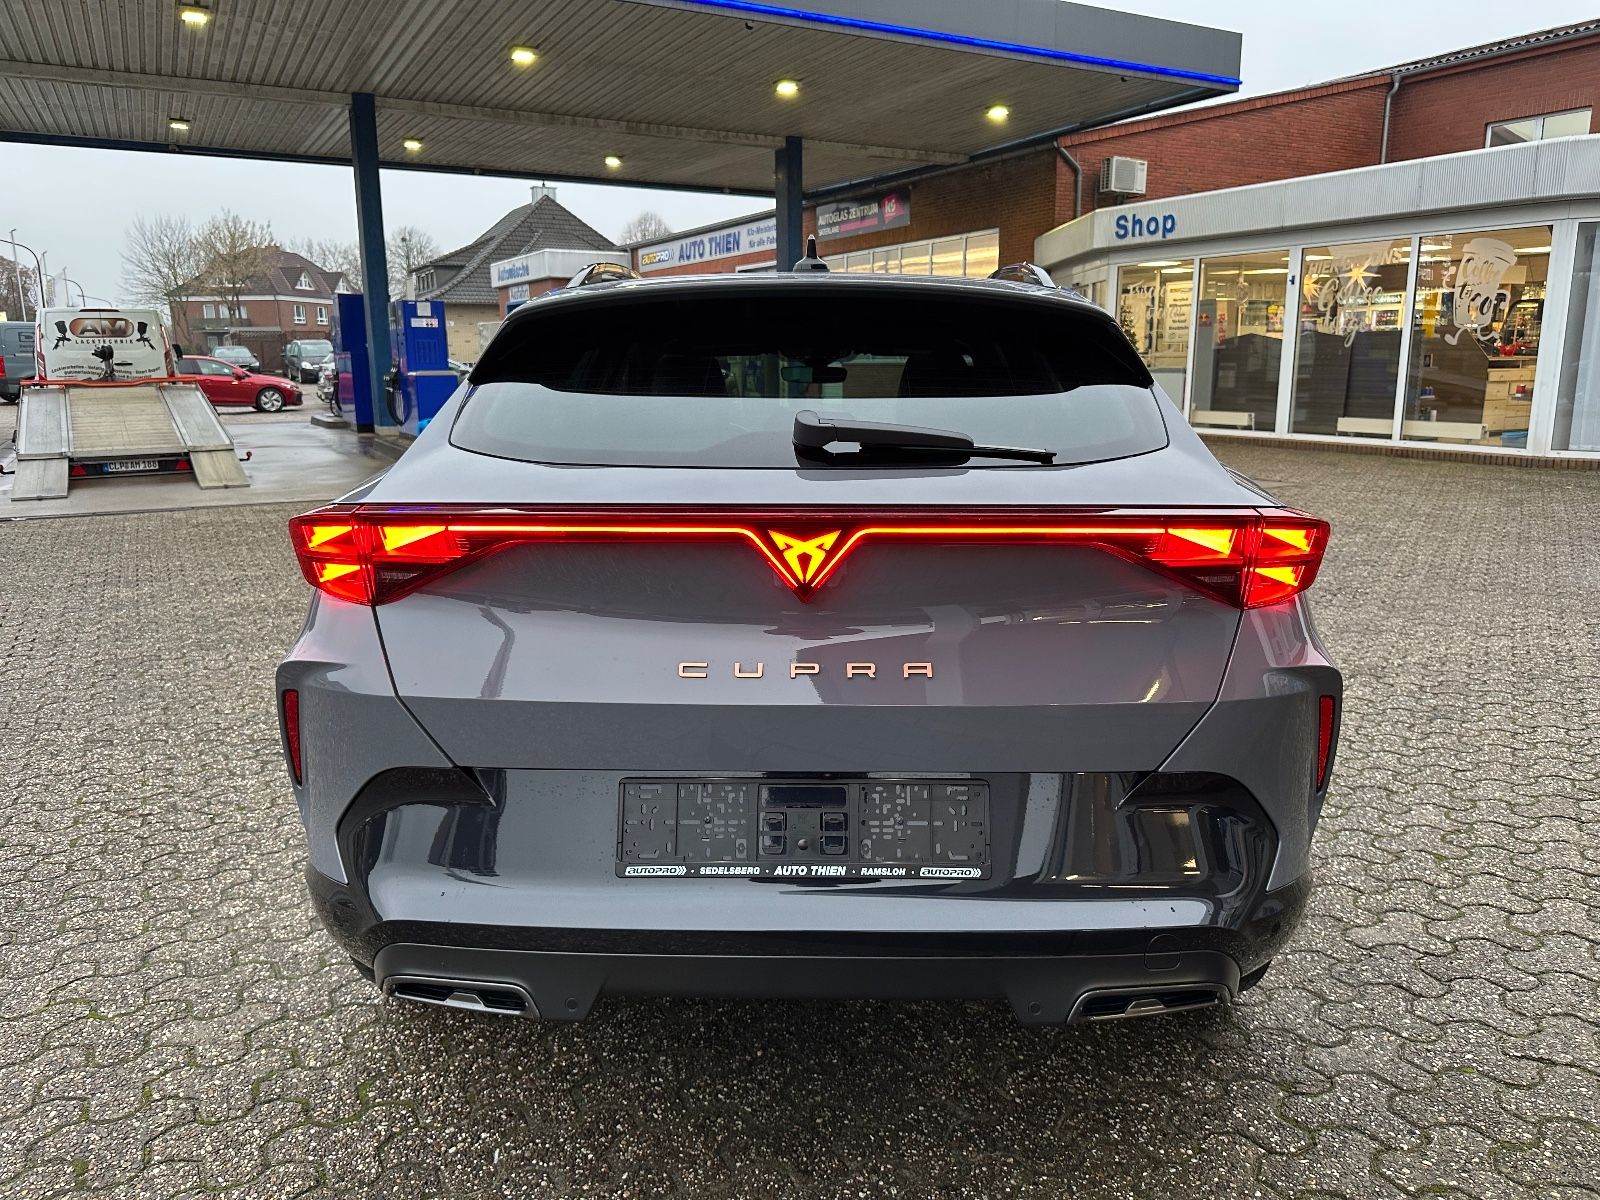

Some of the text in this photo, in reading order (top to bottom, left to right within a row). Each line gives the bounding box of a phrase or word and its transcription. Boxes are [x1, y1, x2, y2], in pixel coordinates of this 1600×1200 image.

[818, 202, 879, 226] AUTOGLAS ZENTRUM
[1115, 213, 1175, 239] Shop
[678, 230, 741, 262] AUTO THIEN
[1308, 261, 1338, 274] HIER
[79, 320, 126, 335] AM
[109, 462, 125, 471] CLP
[130, 461, 141, 469] AM
[678, 662, 934, 679] CUPRA
[699, 866, 760, 875] SEDELSBERG
[774, 866, 807, 876] AUTO
[811, 866, 847, 876] THIEN
[861, 867, 907, 875] RAMSLOH
